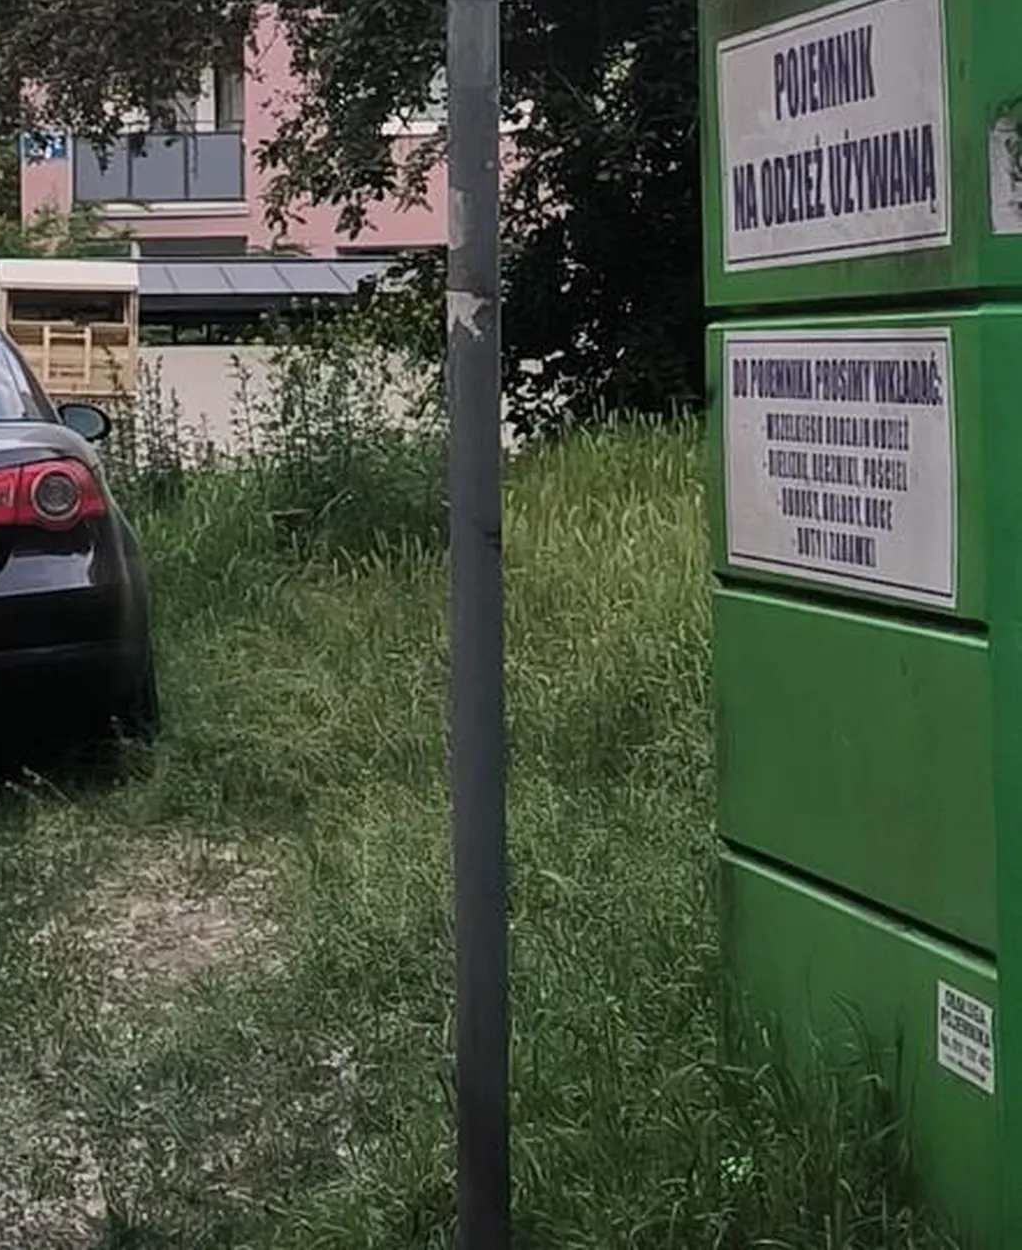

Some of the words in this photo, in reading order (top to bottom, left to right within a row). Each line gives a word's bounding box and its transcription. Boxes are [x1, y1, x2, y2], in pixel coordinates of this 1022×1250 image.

[774, 25, 875, 120] POJEMNIK
[733, 163, 758, 231] NA
[761, 134, 825, 227] ODZIEŻ
[828, 124, 936, 217] UŻYWANĄ
